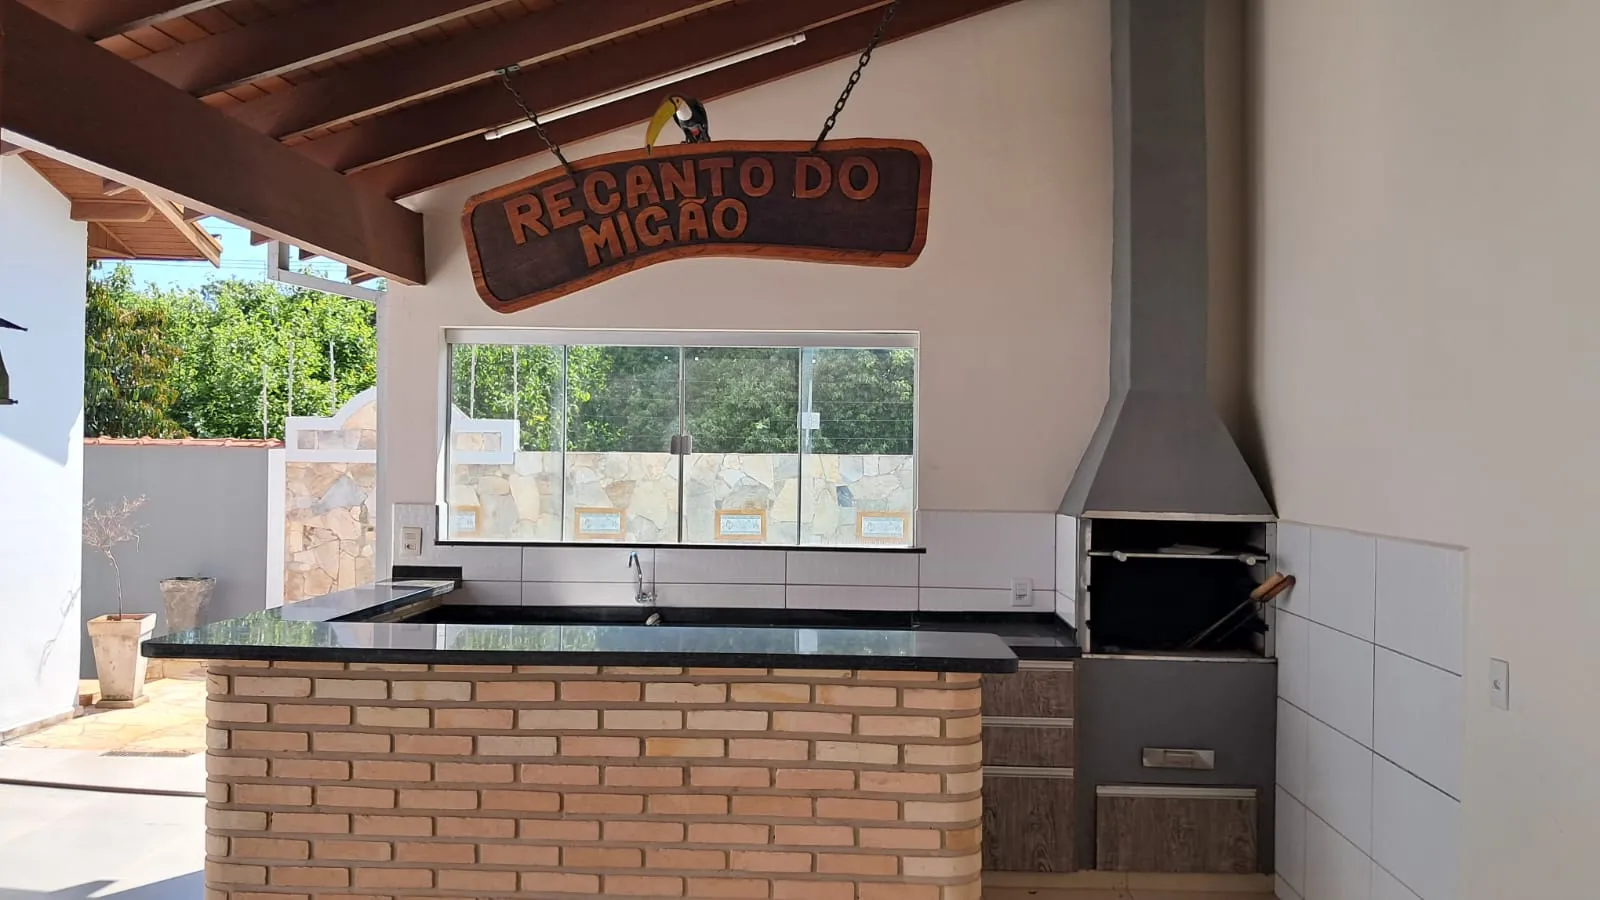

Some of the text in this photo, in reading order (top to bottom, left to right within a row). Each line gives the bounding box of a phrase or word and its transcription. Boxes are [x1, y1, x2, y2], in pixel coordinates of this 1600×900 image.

[503, 155, 879, 245] RECANTO DO
[578, 196, 748, 267] MIGÃO
